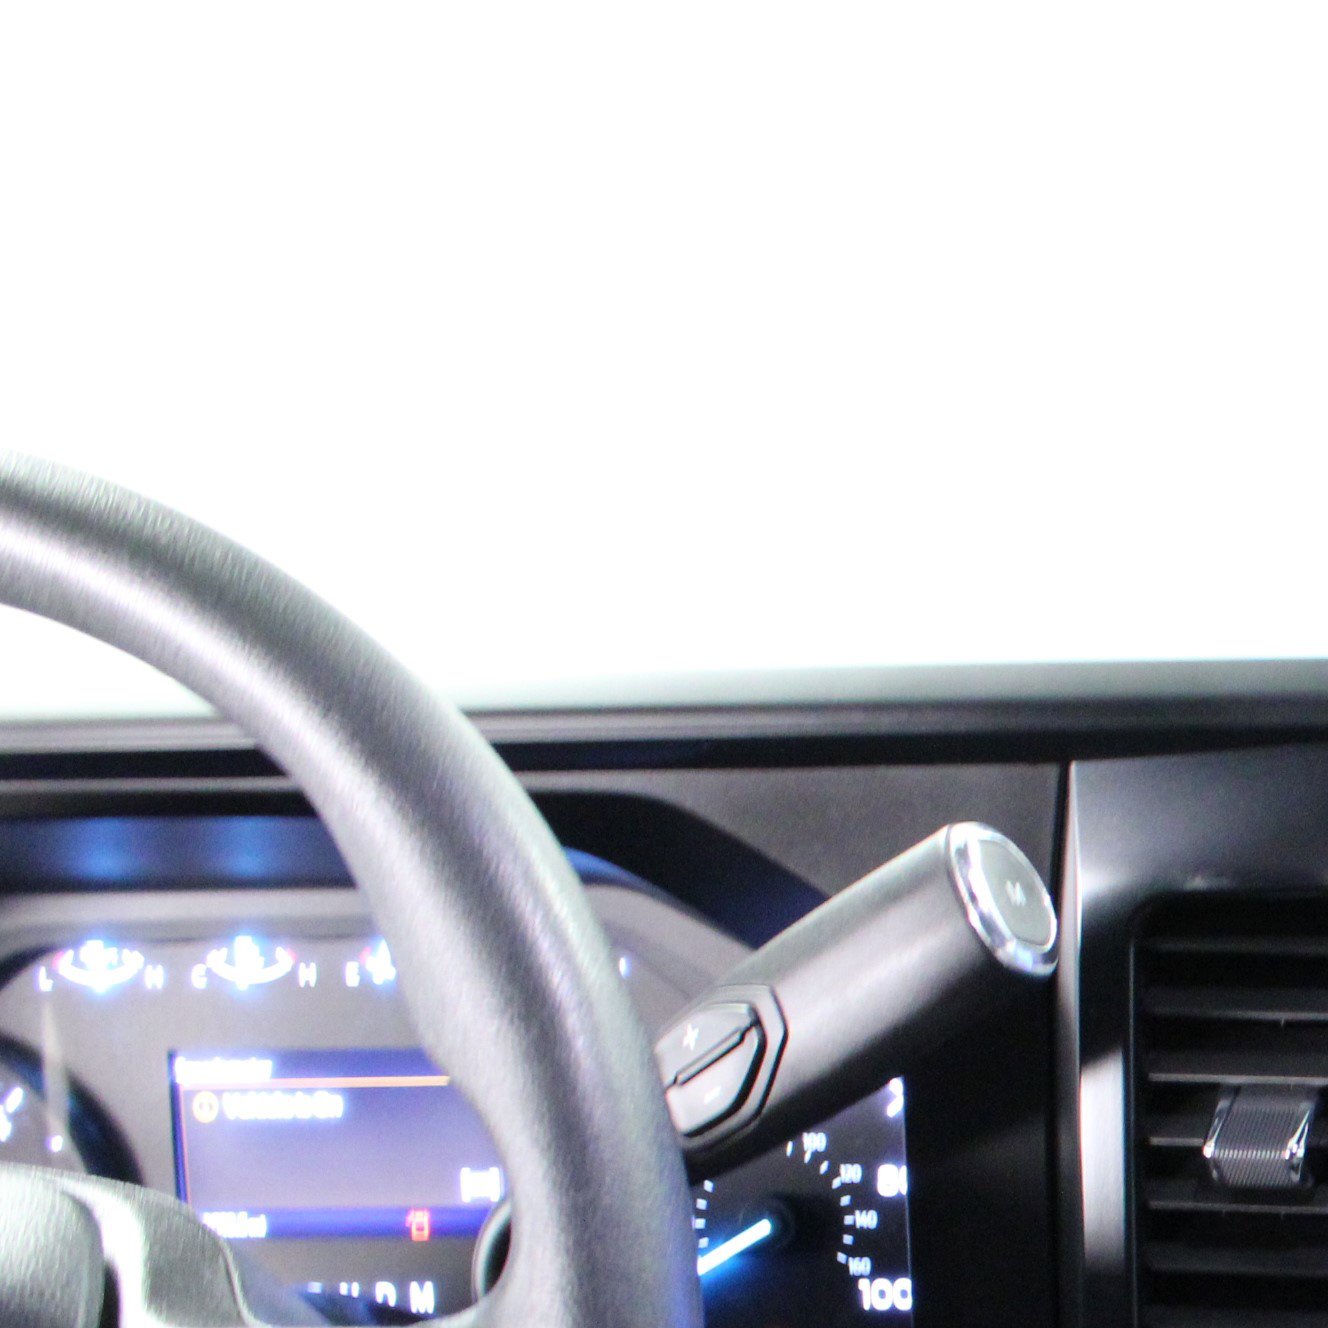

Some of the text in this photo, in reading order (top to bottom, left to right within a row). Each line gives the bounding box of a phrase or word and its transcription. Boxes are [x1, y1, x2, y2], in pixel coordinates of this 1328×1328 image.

[839, 1163, 863, 1184] 120
[854, 1209, 878, 1230] 140
[848, 1256, 872, 1277] 160
[410, 1281, 435, 1314] M
[857, 1277, 913, 1311] 100
